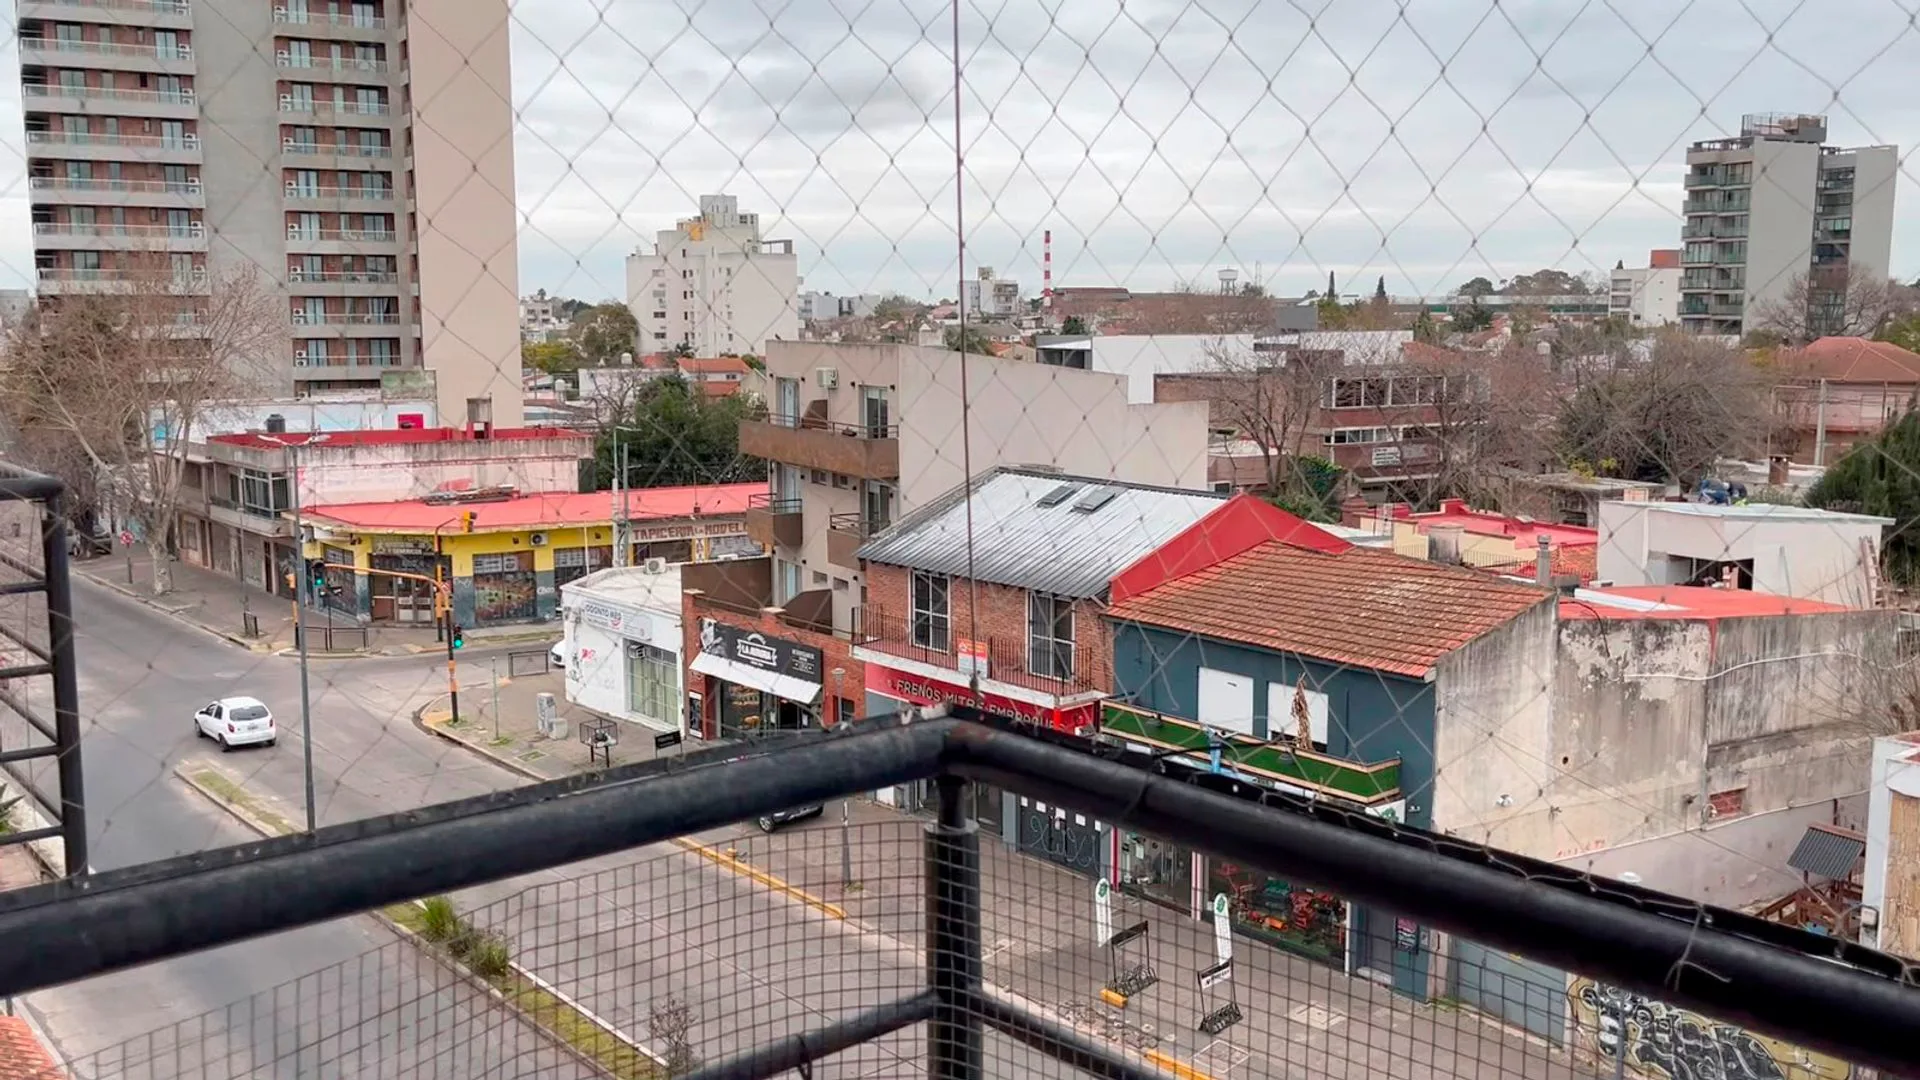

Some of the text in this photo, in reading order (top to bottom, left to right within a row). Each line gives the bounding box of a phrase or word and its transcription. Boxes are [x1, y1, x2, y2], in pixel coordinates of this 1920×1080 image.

[633, 526, 694, 540] TAPICERIA
[896, 679, 941, 702] FRENOS
[944, 691, 985, 710] MITRE
